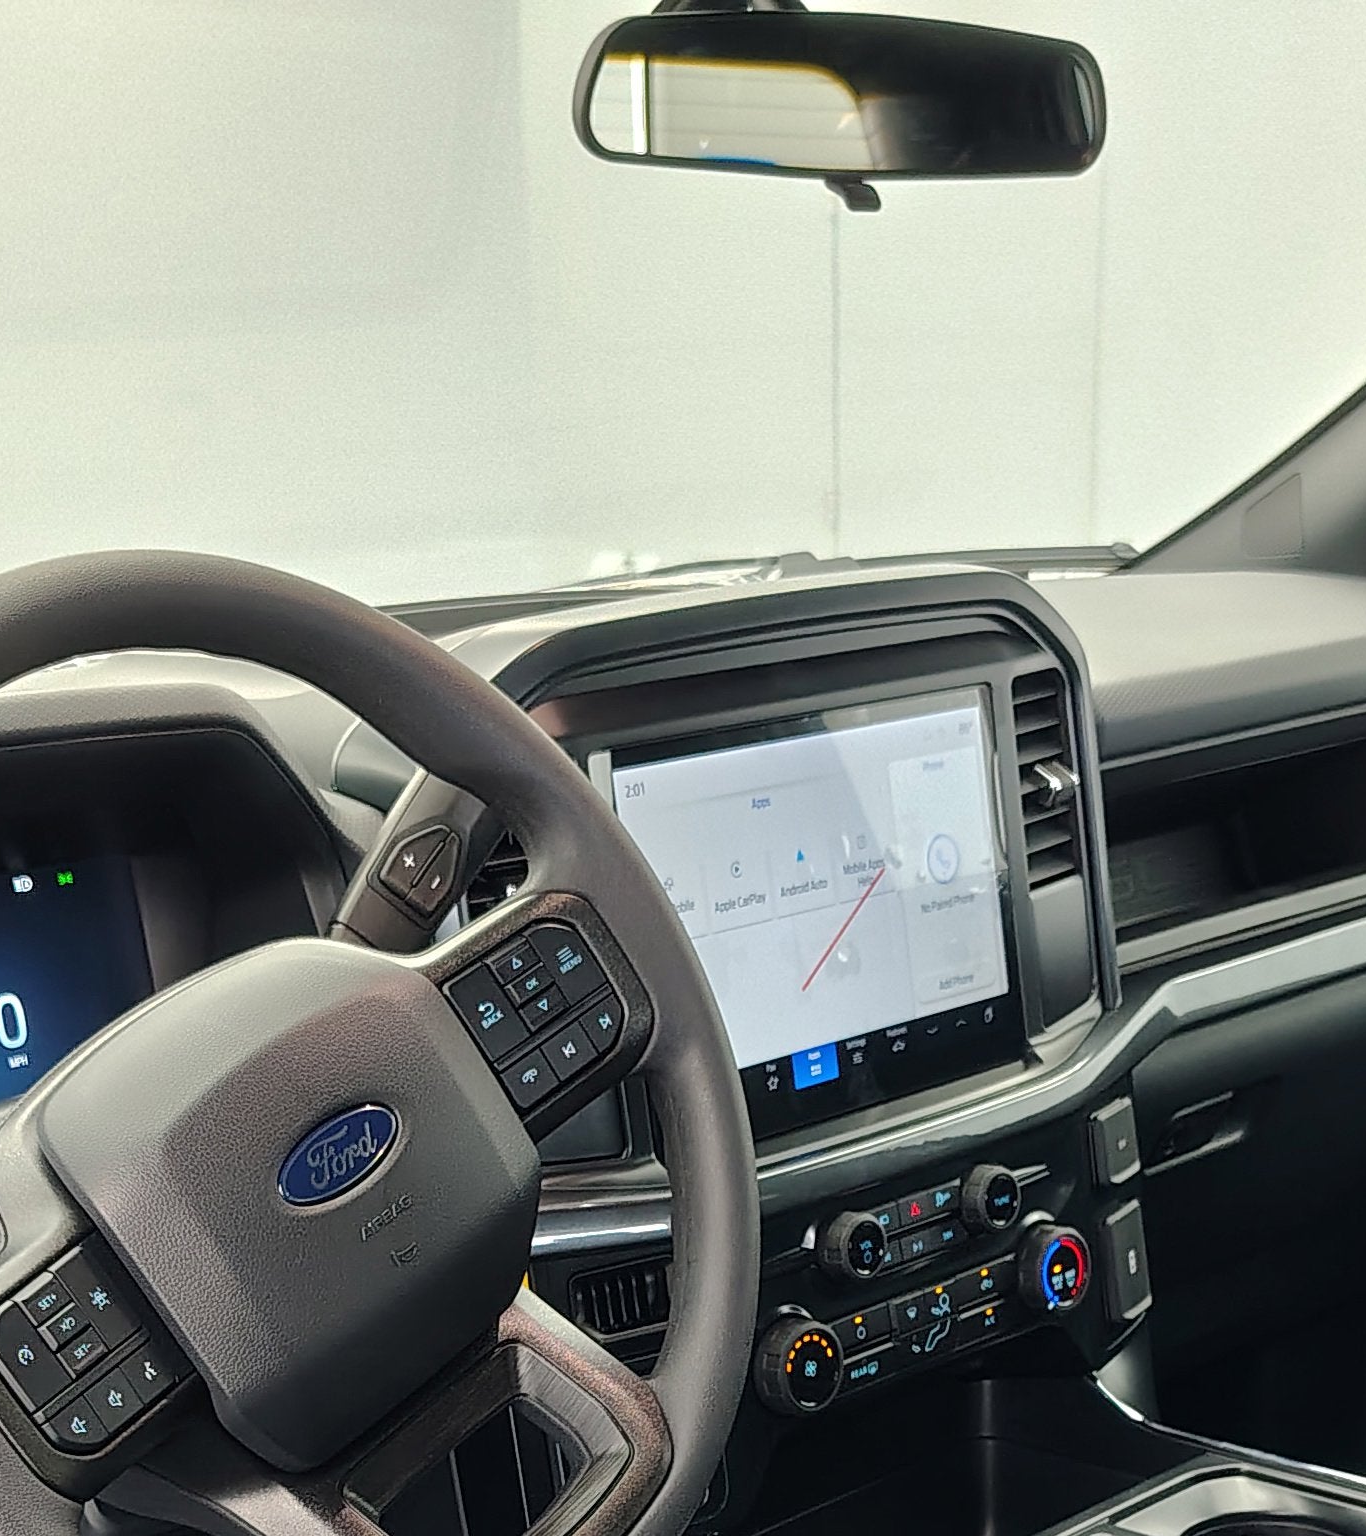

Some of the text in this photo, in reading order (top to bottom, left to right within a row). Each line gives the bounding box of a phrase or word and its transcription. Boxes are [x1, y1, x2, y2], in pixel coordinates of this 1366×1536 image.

[624, 781, 645, 799] 2:01
[751, 797, 772, 811] Apps
[842, 860, 867, 875] Mobile
[780, 878, 828, 898] Android Auto
[675, 899, 696, 913] obile
[715, 892, 767, 915] Apple CarPlay
[559, 954, 584, 974] MENU
[525, 976, 540, 991] OK
[481, 1009, 505, 1030] BACK
[6, 1052, 29, 1069] MPH
[306, 1120, 379, 1190] Ford
[359, 1193, 414, 1241] AIRBAG
[37, 1292, 58, 1311] SET+
[850, 1364, 868, 1380] REAR
